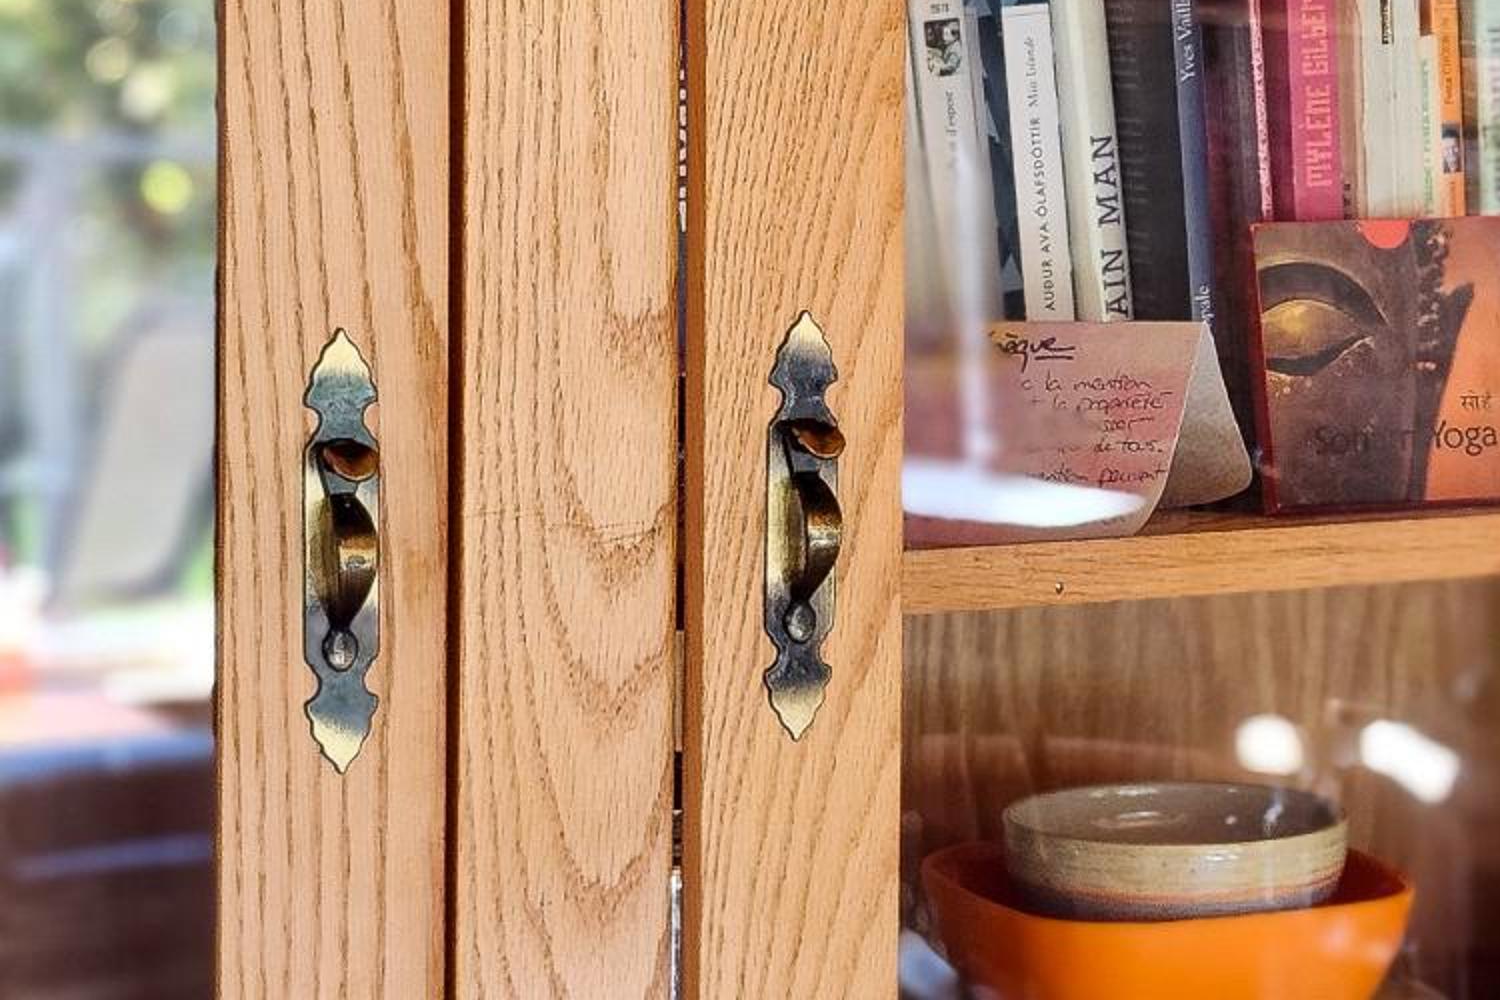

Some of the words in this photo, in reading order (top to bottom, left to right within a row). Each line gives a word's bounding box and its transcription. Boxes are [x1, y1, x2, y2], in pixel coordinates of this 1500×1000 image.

[1180, 44, 1197, 83] Yves
[1090, 134, 1122, 229] MAN
[1037, 223, 1052, 254] AVA
[1431, 419, 1499, 456] Yoga
